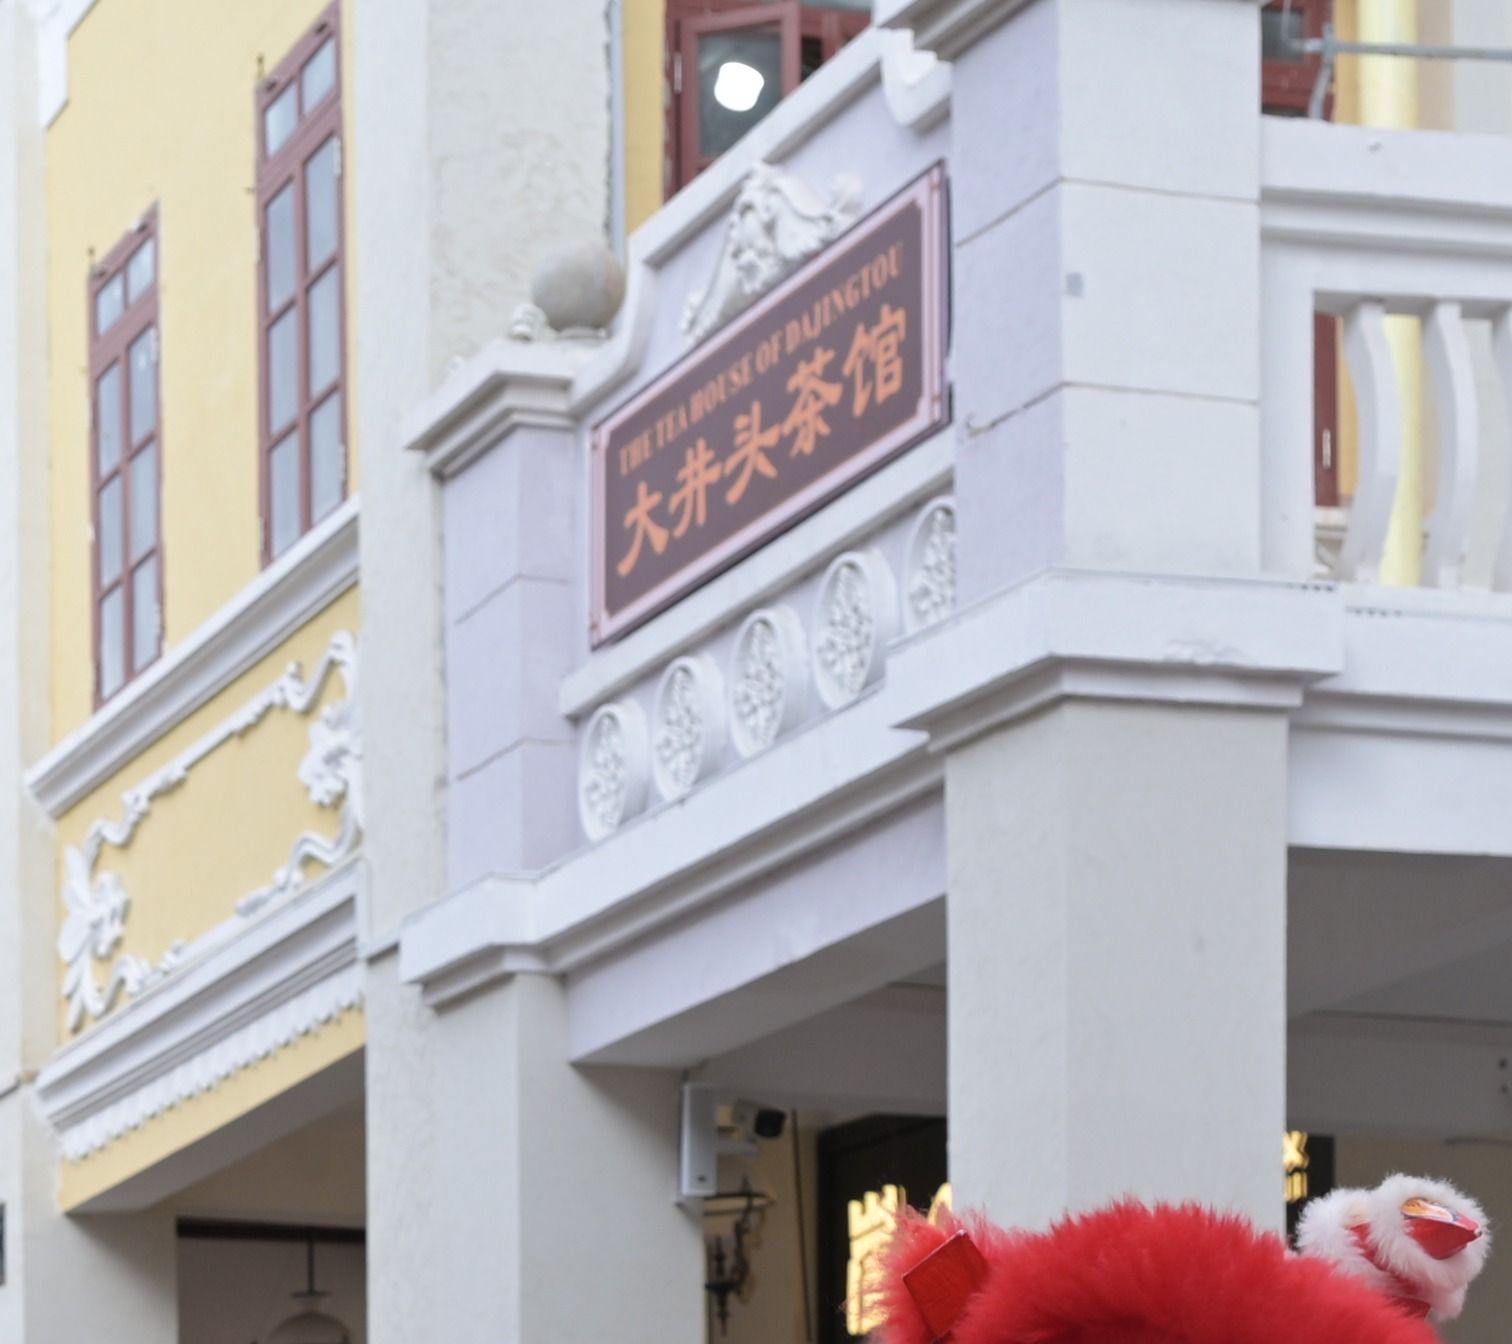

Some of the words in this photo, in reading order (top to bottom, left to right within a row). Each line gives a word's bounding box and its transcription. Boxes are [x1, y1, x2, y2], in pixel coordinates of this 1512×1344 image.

[616, 304, 907, 577] 大井头茶馆
[620, 430, 654, 477] THE
[656, 405, 689, 449] TEA
[690, 354, 754, 424] HOUSE
[755, 331, 783, 374] OF
